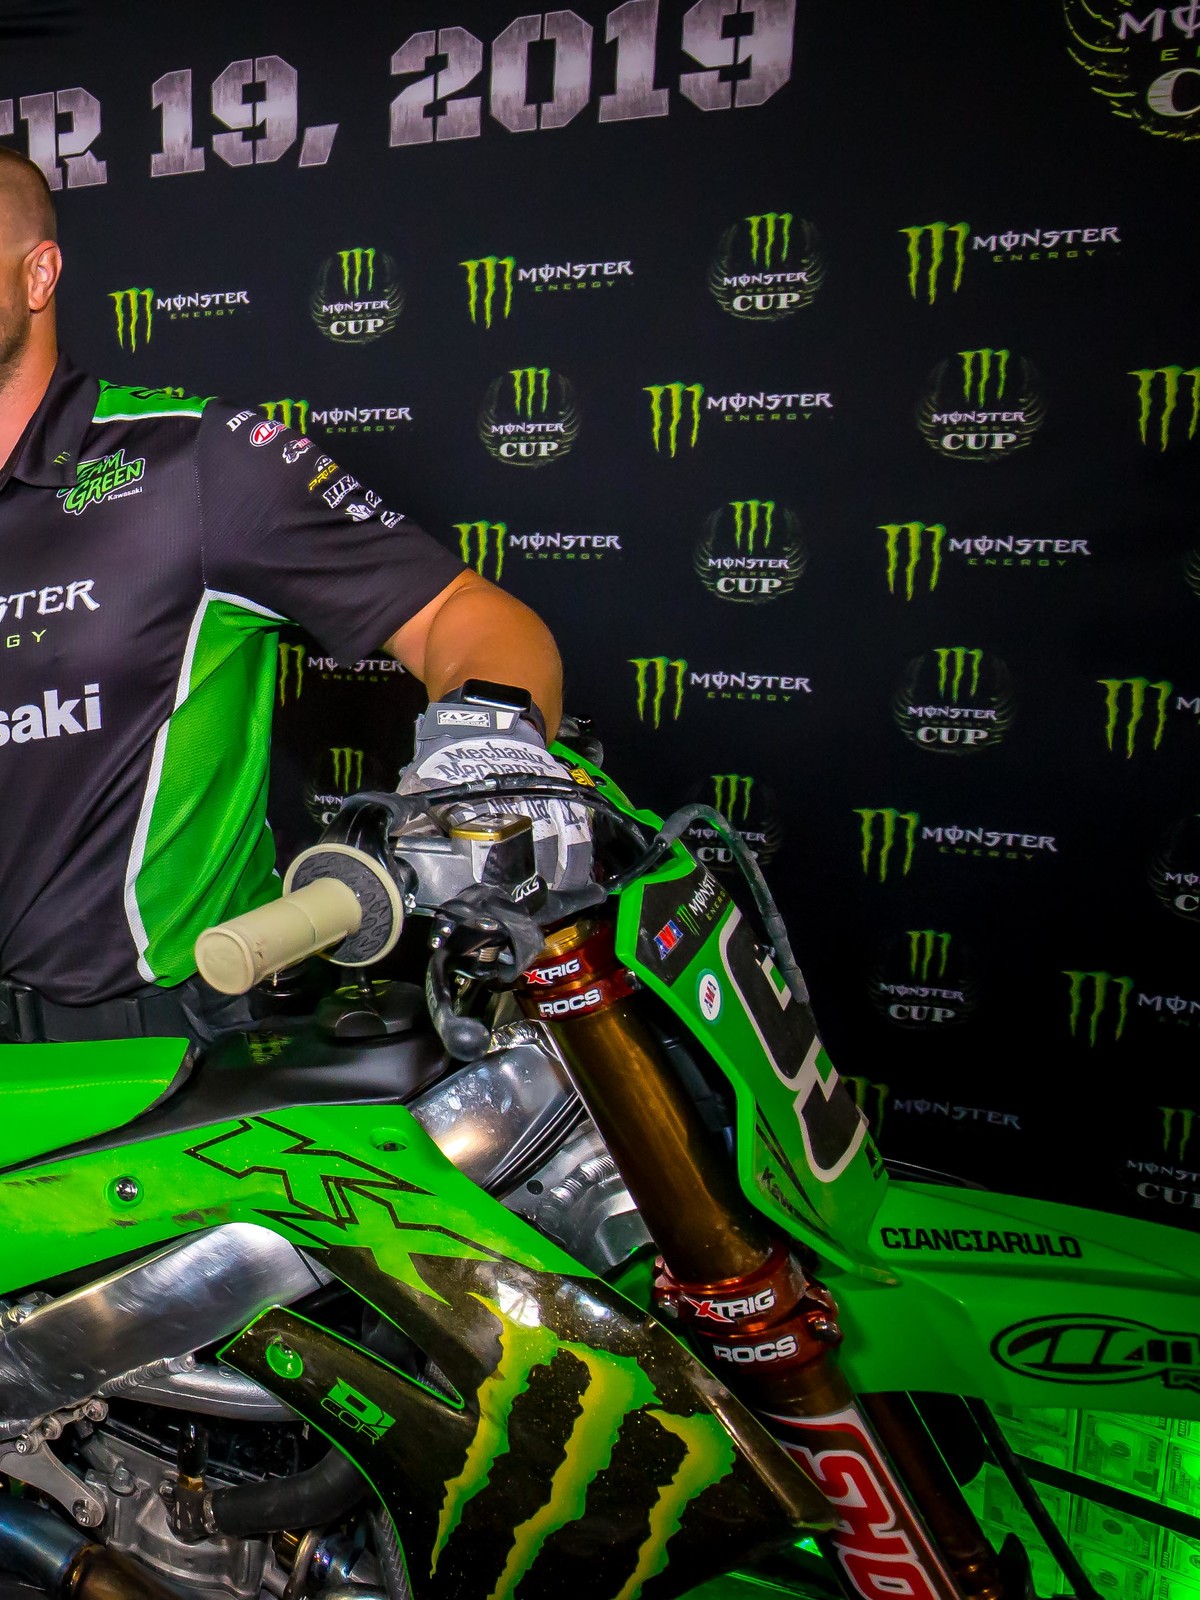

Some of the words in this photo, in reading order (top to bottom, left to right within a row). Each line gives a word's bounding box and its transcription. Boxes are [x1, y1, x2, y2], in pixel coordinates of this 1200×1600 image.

[152, 54, 338, 177] 19,
[389, 0, 795, 147] 2019
[972, 226, 1121, 252] MONSTER
[518, 260, 633, 283] MONSTER
[723, 271, 808, 287] MONSTER
[157, 291, 249, 310] MONSTER
[322, 299, 390, 314] MONSTER
[732, 292, 800, 312] CUP
[330, 318, 384, 335] CUP
[707, 391, 833, 412] MONSTER
[311, 407, 413, 424] MONSTER
[931, 410, 1027, 424] MONSTER
[491, 421, 565, 435] MONSTER
[499, 441, 559, 457] CUP
[940, 432, 1018, 451] CUP
[65, 461, 142, 512] GREEN
[107, 487, 143, 500] Kawasaki
[508, 531, 622, 550] MONSTER
[949, 535, 1091, 555] MONSTER
[708, 556, 790, 570] MONSTER
[716, 577, 783, 594] CUP
[308, 656, 406, 672] MOSTER
[691, 671, 812, 692] MONSTER
[907, 705, 997, 720] MONSTER
[916, 726, 989, 745] CUP
[688, 827, 768, 843] MONTER
[922, 825, 1059, 852] MONSTER
[523, 959, 580, 985] XTRIG
[539, 989, 602, 1016] ROCS
[888, 1003, 956, 1023] CUP
[893, 1098, 1022, 1130] MONSTER
[880, 1226, 1084, 1259] CIANCIARULO
[682, 1288, 776, 1323] XTRIG
[713, 1335, 798, 1363] ROCS
[780, 1441, 950, 1600] SHO
